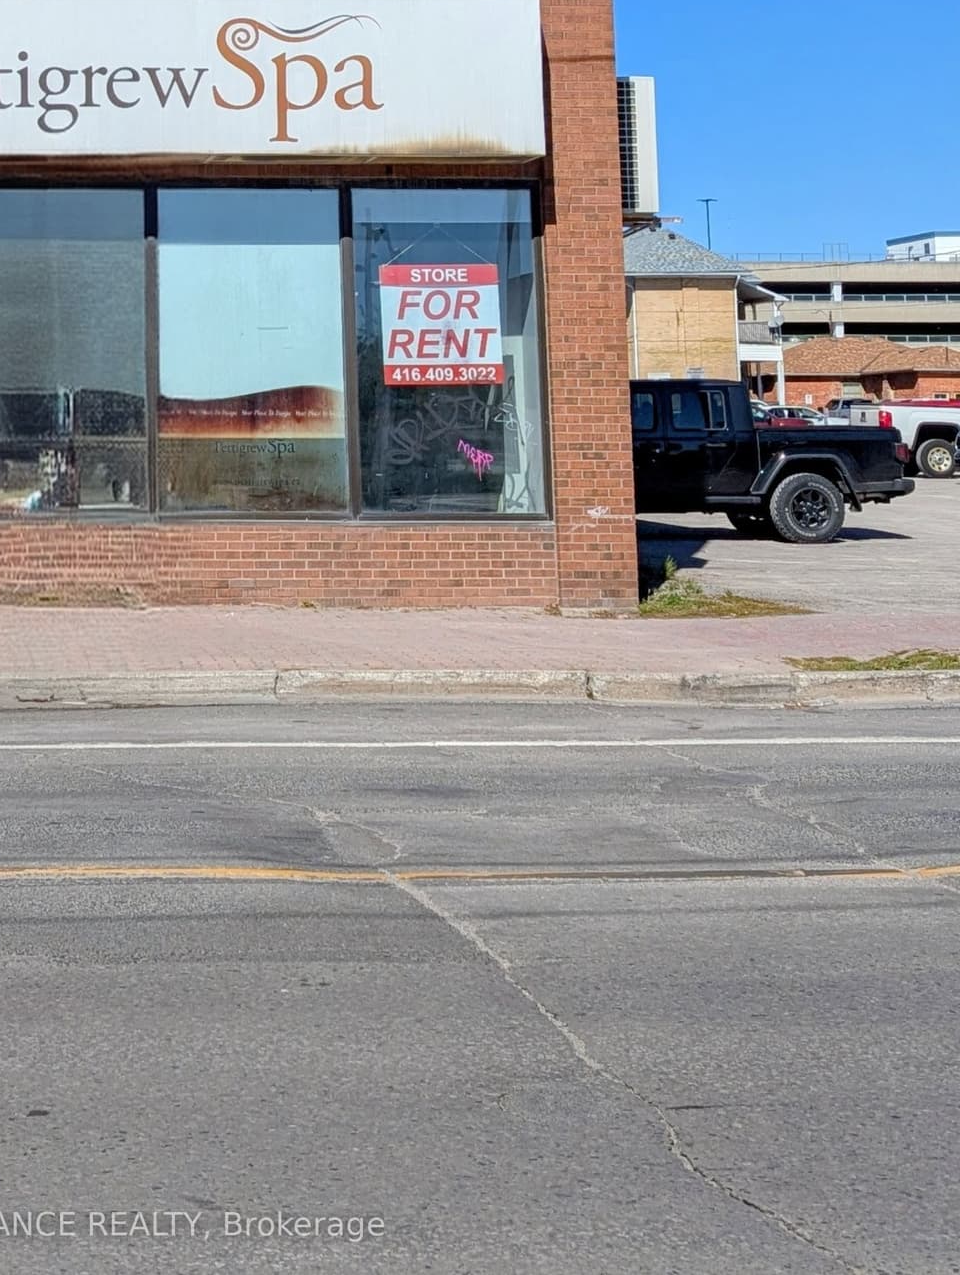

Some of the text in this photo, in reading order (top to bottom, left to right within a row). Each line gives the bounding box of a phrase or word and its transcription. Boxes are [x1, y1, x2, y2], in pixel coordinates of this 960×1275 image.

[212, 14, 384, 142] Spa
[410, 268, 468, 282] STORE
[397, 289, 481, 320] FOR
[387, 328, 497, 359] RENT
[392, 367, 496, 381] 416.409.3022
[267, 438, 296, 458] Spa
